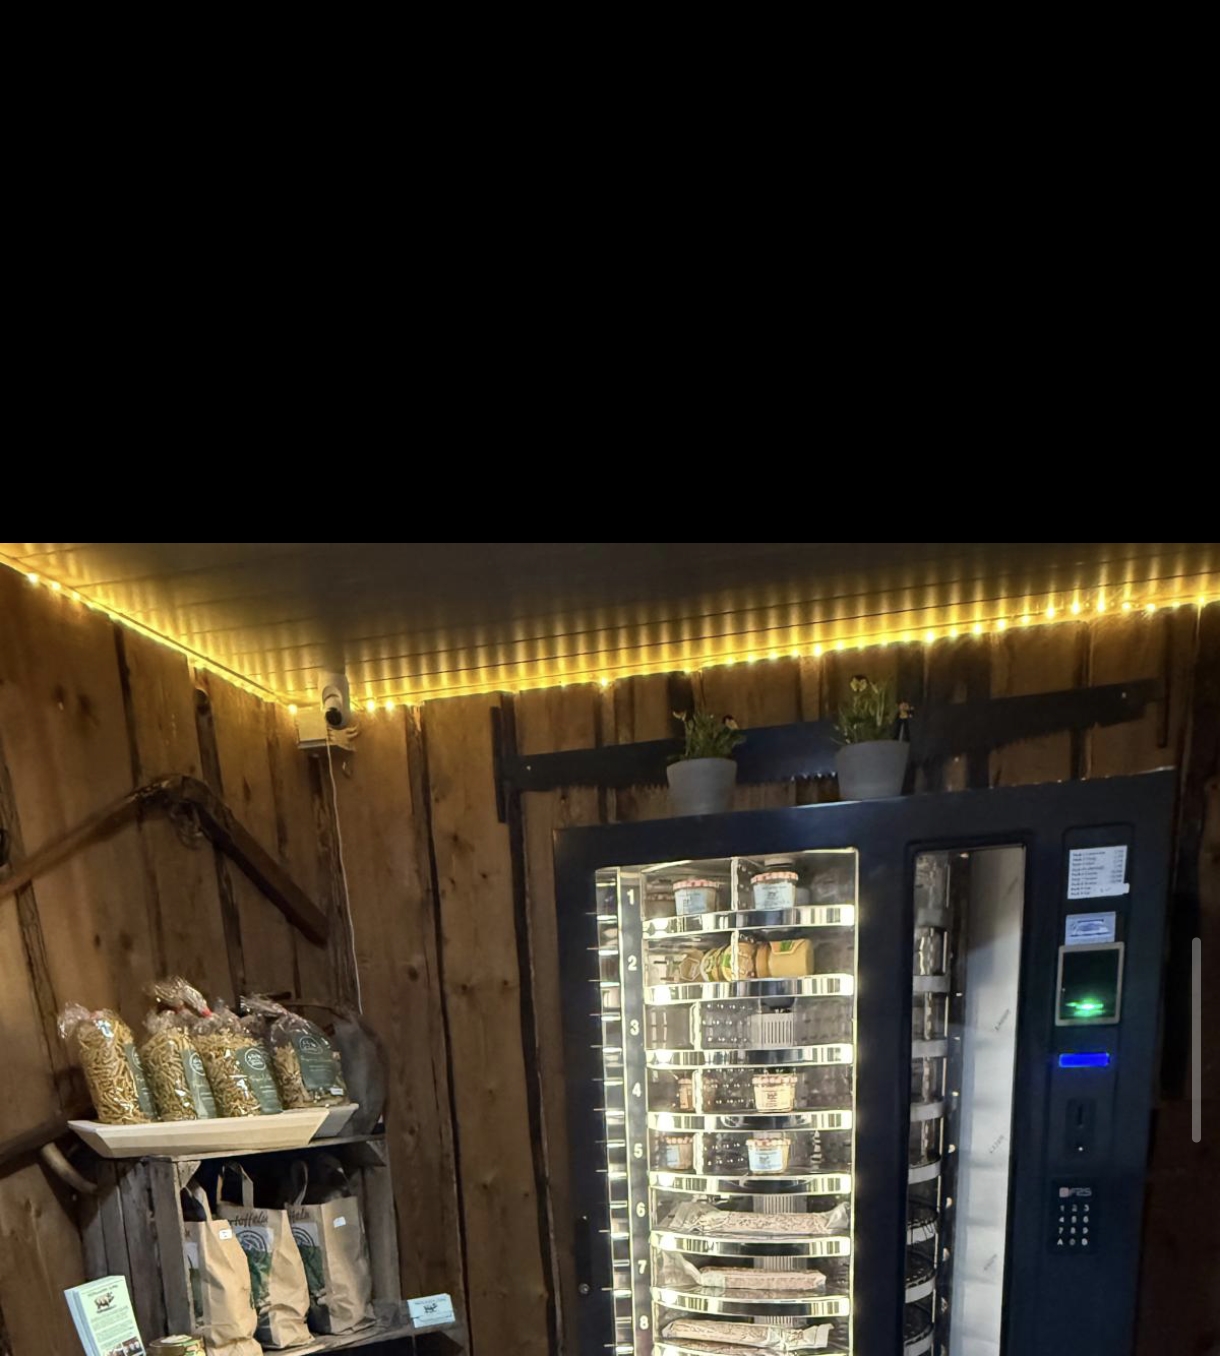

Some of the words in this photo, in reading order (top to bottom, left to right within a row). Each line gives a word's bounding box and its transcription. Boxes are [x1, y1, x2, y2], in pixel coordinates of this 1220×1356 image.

[627, 889, 635, 905] 1
[628, 955, 637, 971] 2
[630, 1019, 639, 1036] 3
[632, 1082, 642, 1097] 4
[634, 1143, 643, 1158] 5
[636, 1202, 646, 1218] 6
[228, 1210, 269, 1228] rtoffeln
[638, 1260, 647, 1274] 7
[639, 1315, 649, 1330] 8
